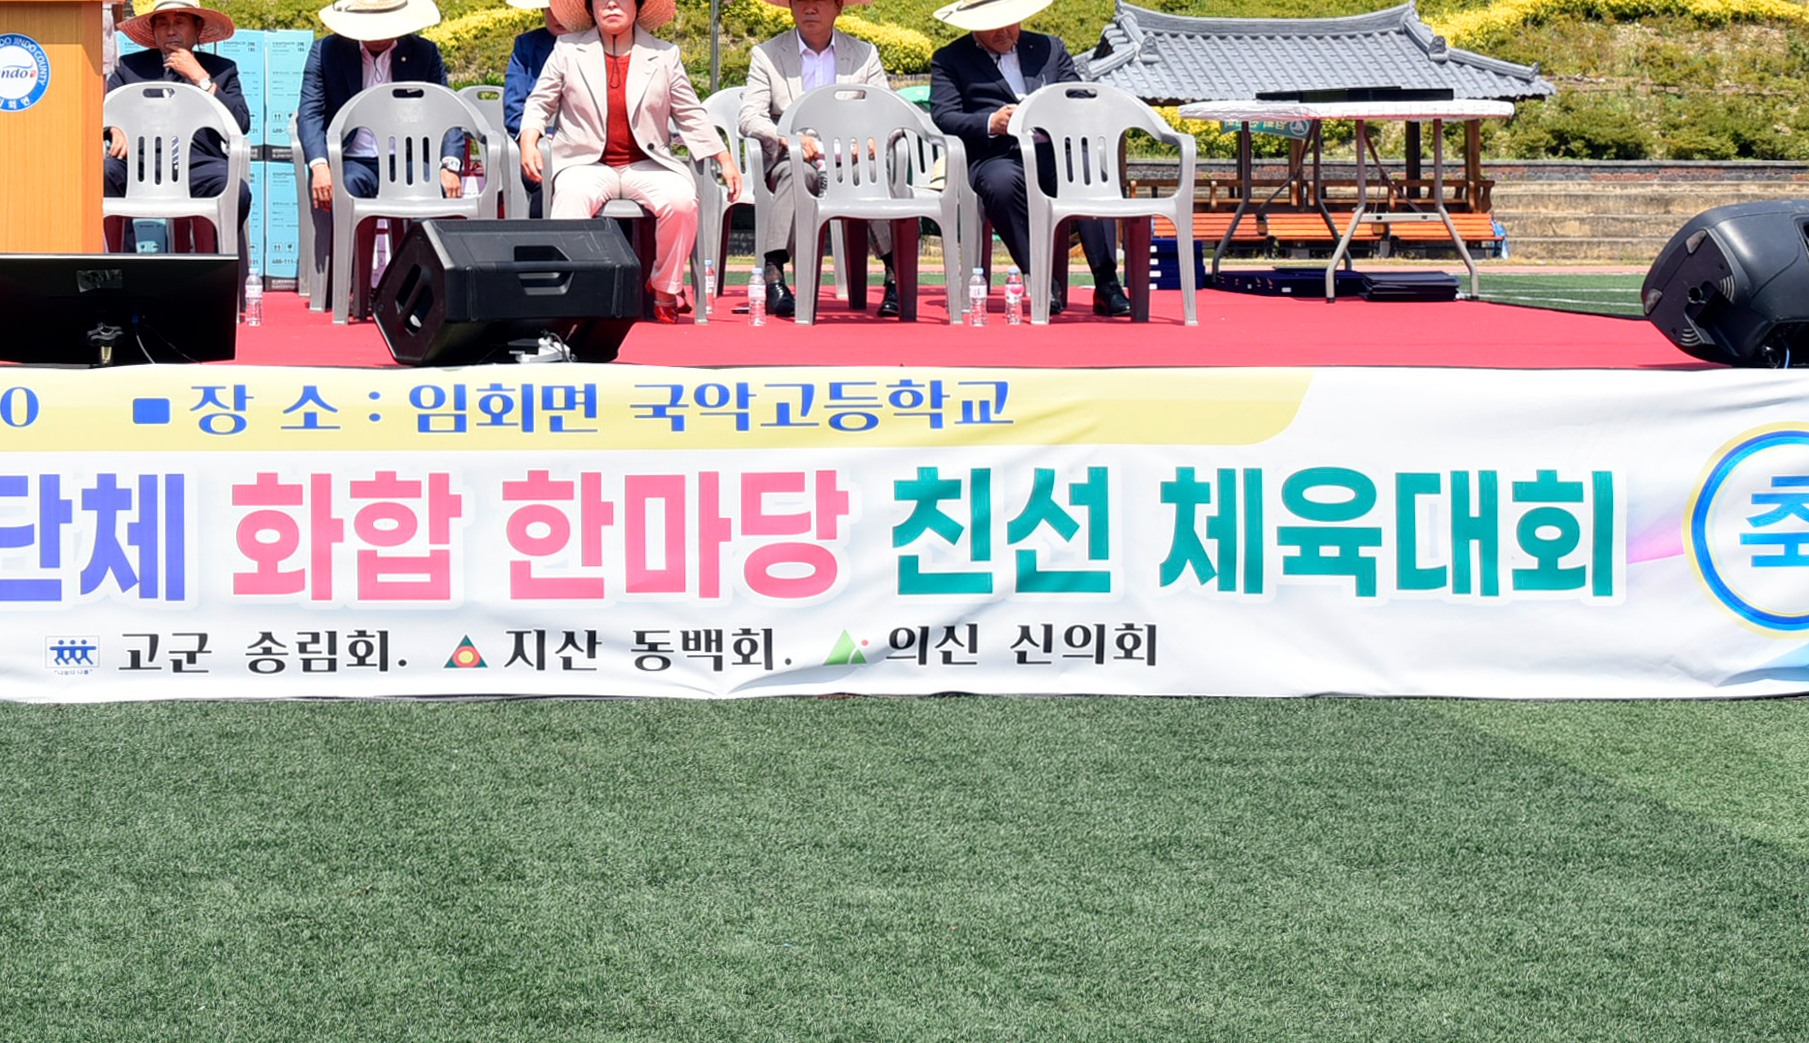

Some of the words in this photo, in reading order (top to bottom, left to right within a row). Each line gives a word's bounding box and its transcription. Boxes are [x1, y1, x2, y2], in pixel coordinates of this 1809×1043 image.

[13, 37, 37, 53] JINDO
[33, 51, 47, 86] COUNTY
[409, 383, 598, 433] 임회면
[631, 378, 1015, 432] 국악고등학교
[232, 470, 462, 601] 화합
[502, 469, 850, 600] 한마당
[892, 466, 1112, 596] 친선
[1159, 466, 1615, 598] 체육대회
[118, 632, 213, 673] 고군
[244, 630, 408, 674] 송림회.
[503, 629, 602, 671] 지산
[630, 628, 792, 672] 동백회.
[886, 623, 979, 666] 의신
[1009, 623, 1158, 667] 신의회
